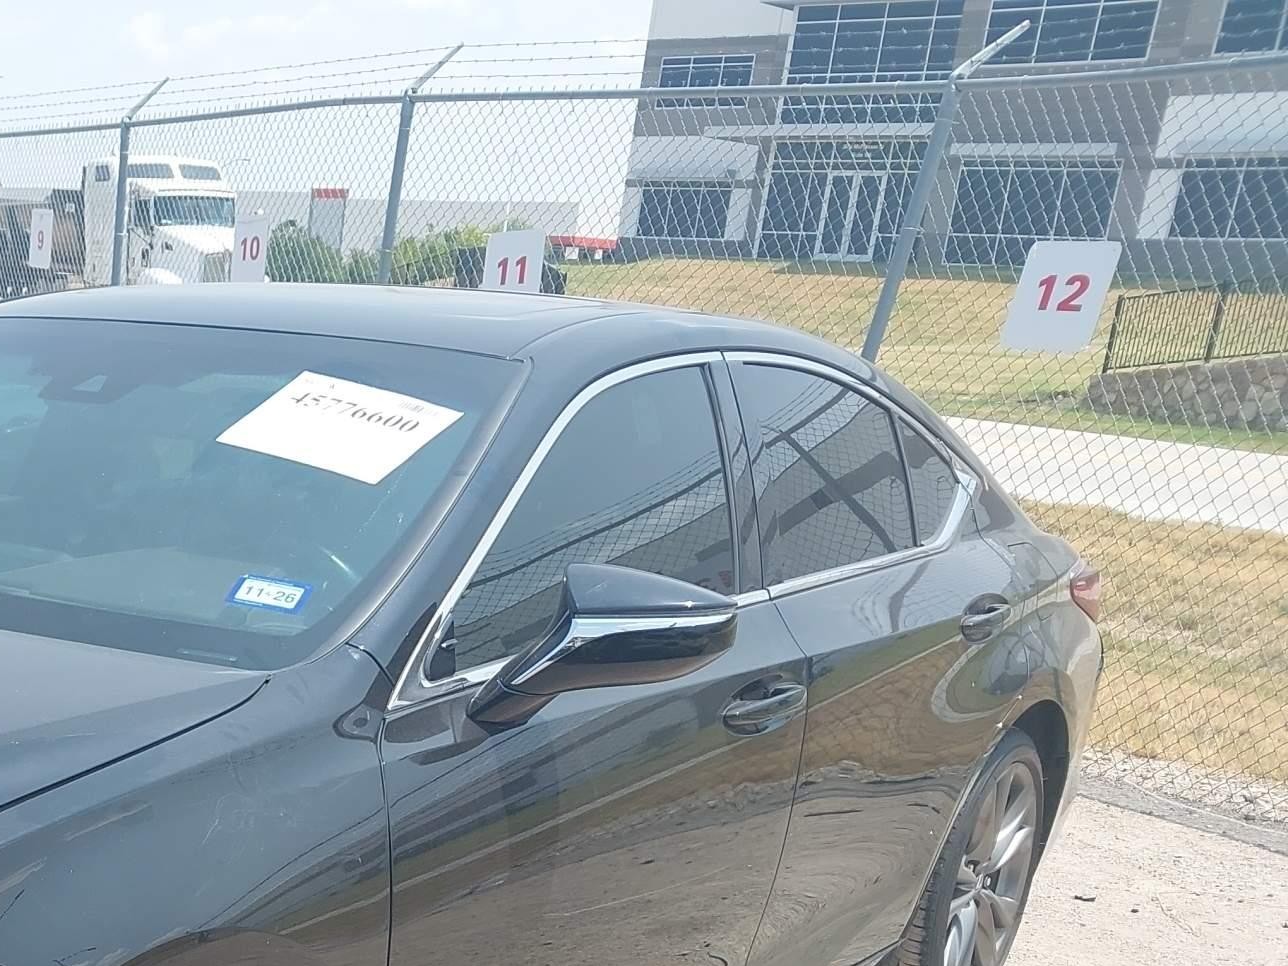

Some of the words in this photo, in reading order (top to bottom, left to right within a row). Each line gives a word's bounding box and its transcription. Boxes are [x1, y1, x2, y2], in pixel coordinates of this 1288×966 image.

[37, 230, 45, 250] 9
[241, 235, 260, 261] 10
[497, 255, 527, 285] 11
[1038, 274, 1091, 312] 12
[290, 392, 420, 432] 45776600
